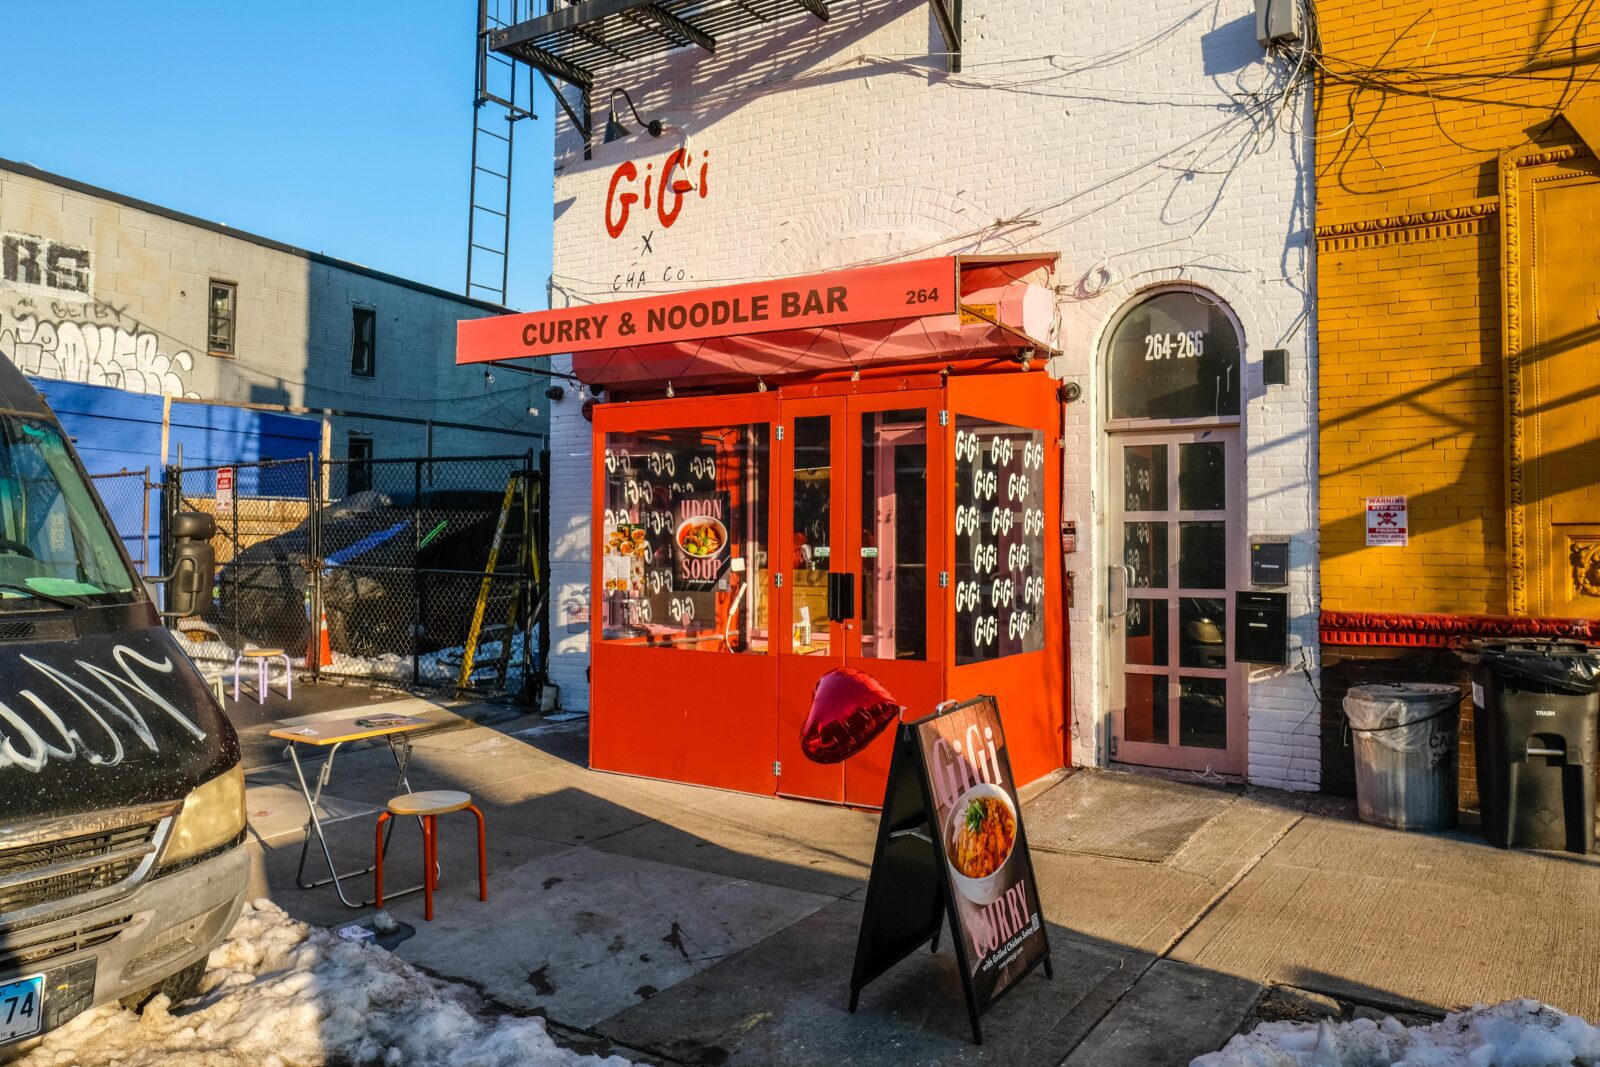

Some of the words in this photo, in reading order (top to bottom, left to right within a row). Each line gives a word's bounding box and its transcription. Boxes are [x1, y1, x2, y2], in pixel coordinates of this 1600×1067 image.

[605, 148, 708, 239] GiGi
[613, 271, 646, 291] CHA
[906, 288, 939, 305] 264
[522, 315, 608, 346] CURRY
[617, 312, 636, 336] &
[647, 295, 769, 333] NOODLE
[781, 286, 848, 318] BAR
[1145, 330, 1203, 361] 264-266
[955, 431, 979, 463] GiGi
[992, 436, 1013, 467] GiGi
[1025, 441, 1044, 470] GiGi
[974, 470, 997, 501] GiGi
[1008, 473, 1029, 502] GiGi
[681, 499, 722, 520] UDON
[955, 505, 979, 537] GiGi
[992, 506, 1013, 537] GiGi
[1025, 508, 1044, 536] GiGi
[682, 559, 721, 579] SOUP
[974, 543, 997, 574] GiGi
[1009, 543, 1029, 572] GiGi
[956, 581, 980, 612] GiGi
[992, 578, 1014, 608] GiGi
[1025, 576, 1044, 604] GiGi
[975, 615, 997, 647] GiGi
[1009, 611, 1030, 640] GiGi
[933, 725, 1003, 808] GiGi
[972, 880, 1030, 959] CURRY
[1007, 936, 1022, 951] Chicken
[5, 991, 34, 1025] 74
